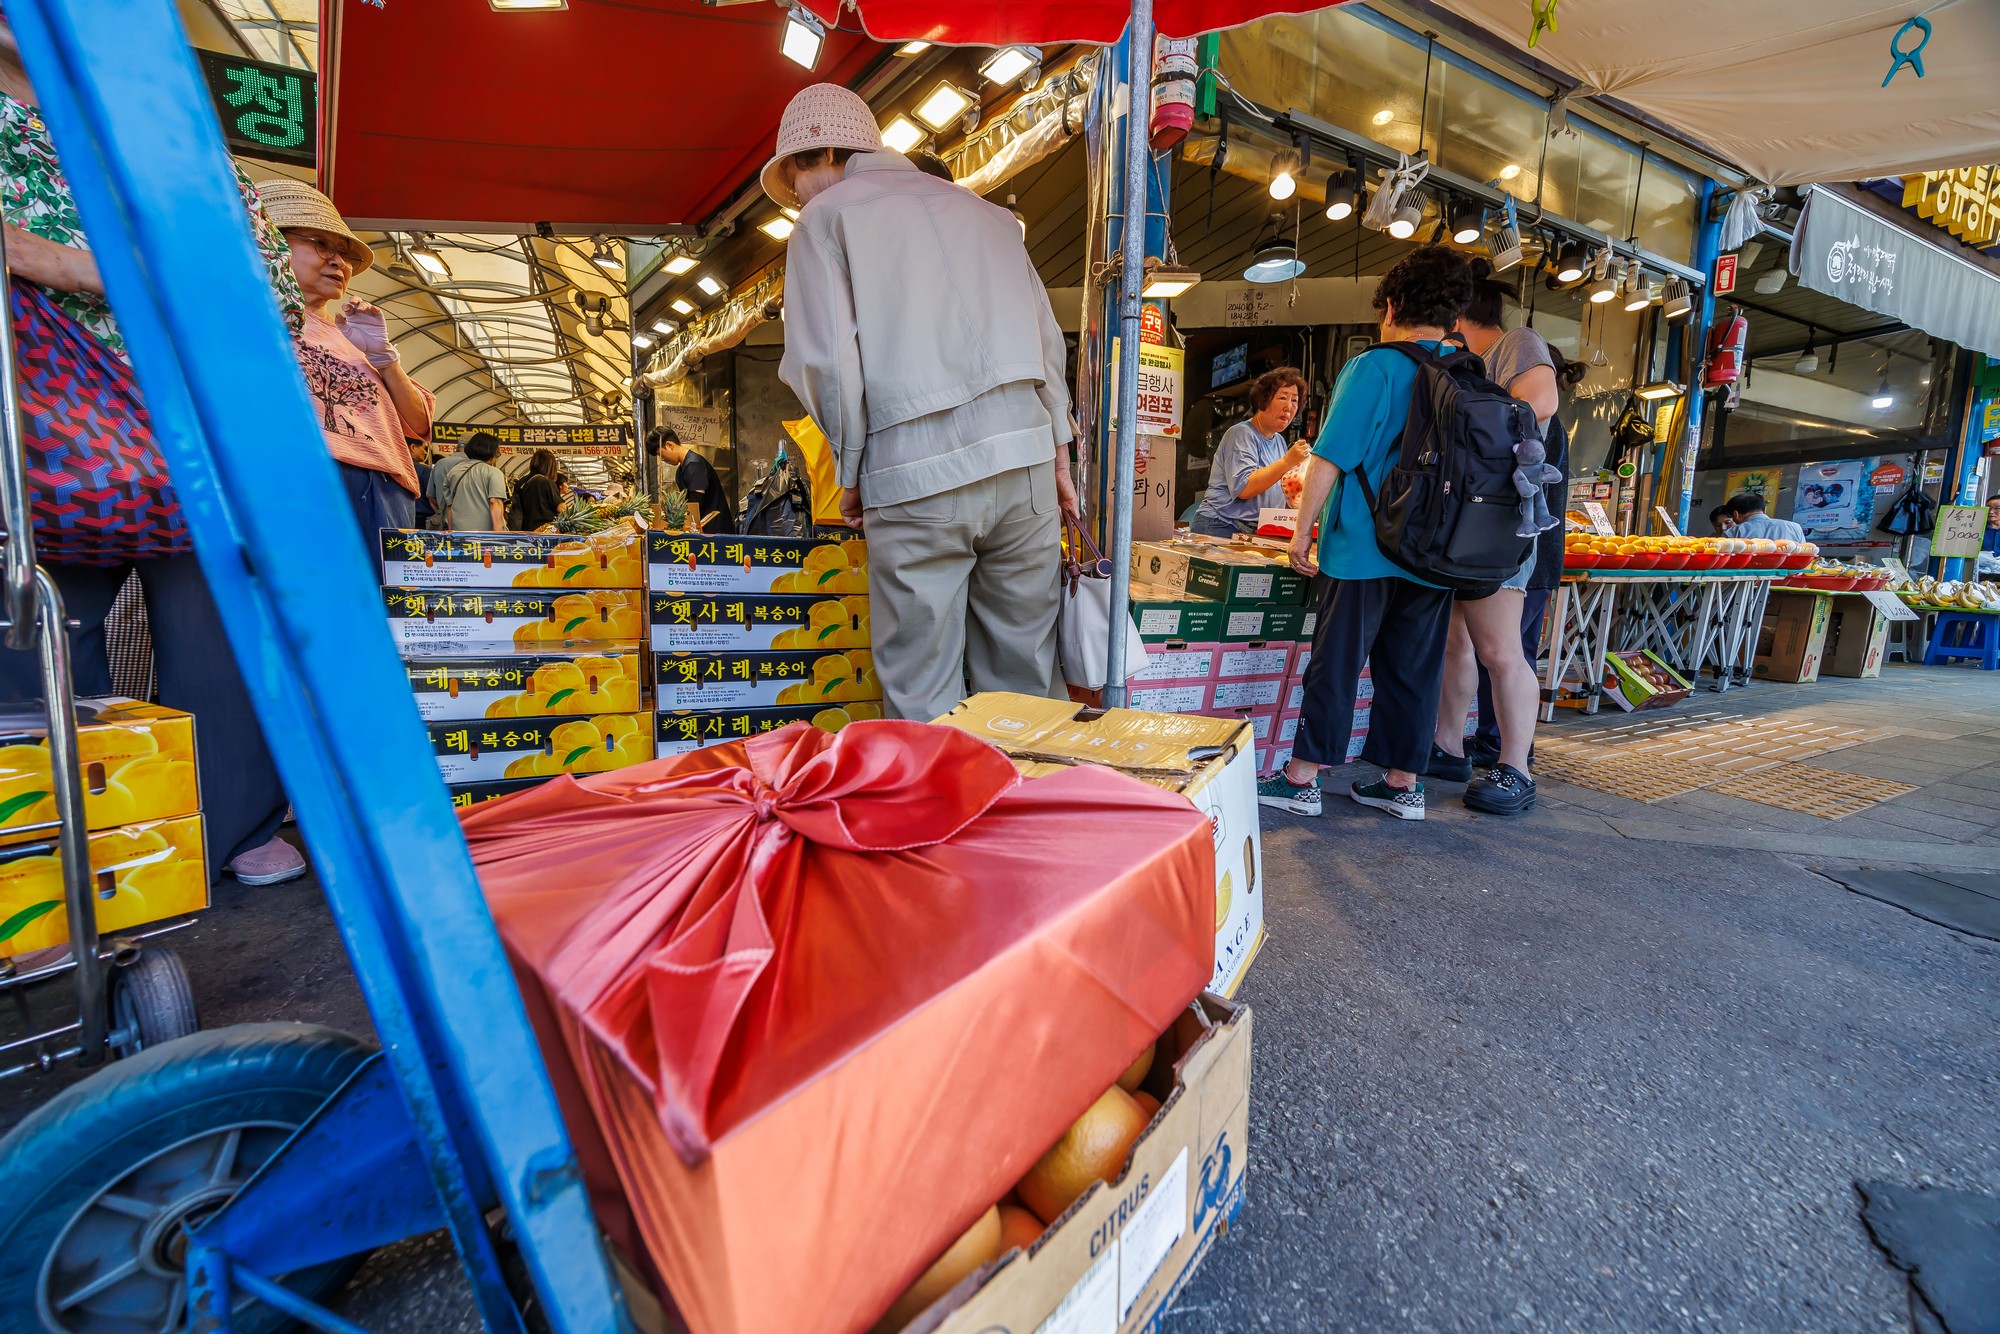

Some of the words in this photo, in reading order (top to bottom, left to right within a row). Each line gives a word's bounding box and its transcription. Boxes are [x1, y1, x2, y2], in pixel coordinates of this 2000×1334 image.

[597, 428, 620, 442] 보상
[584, 446, 622, 455] 1566-3709
[404, 540, 482, 561] 햇사레
[493, 545, 544, 561] 복숭아
[671, 541, 744, 564] 햇사레
[753, 548, 801, 564] 복숭아
[405, 597, 483, 617] 햇사레
[494, 600, 544, 614] 복숭아
[673, 601, 744, 623] 햇사레
[754, 605, 802, 621] 복숭아
[462, 669, 524, 687] 복숭아
[678, 659, 750, 683] 햇사레
[759, 662, 806, 677] 복숭아
[678, 715, 750, 740] 햇사레
[481, 730, 542, 748] 복숭아
[1207, 912, 1250, 989] ANGE
[1090, 1173, 1150, 1258] CITRUS
